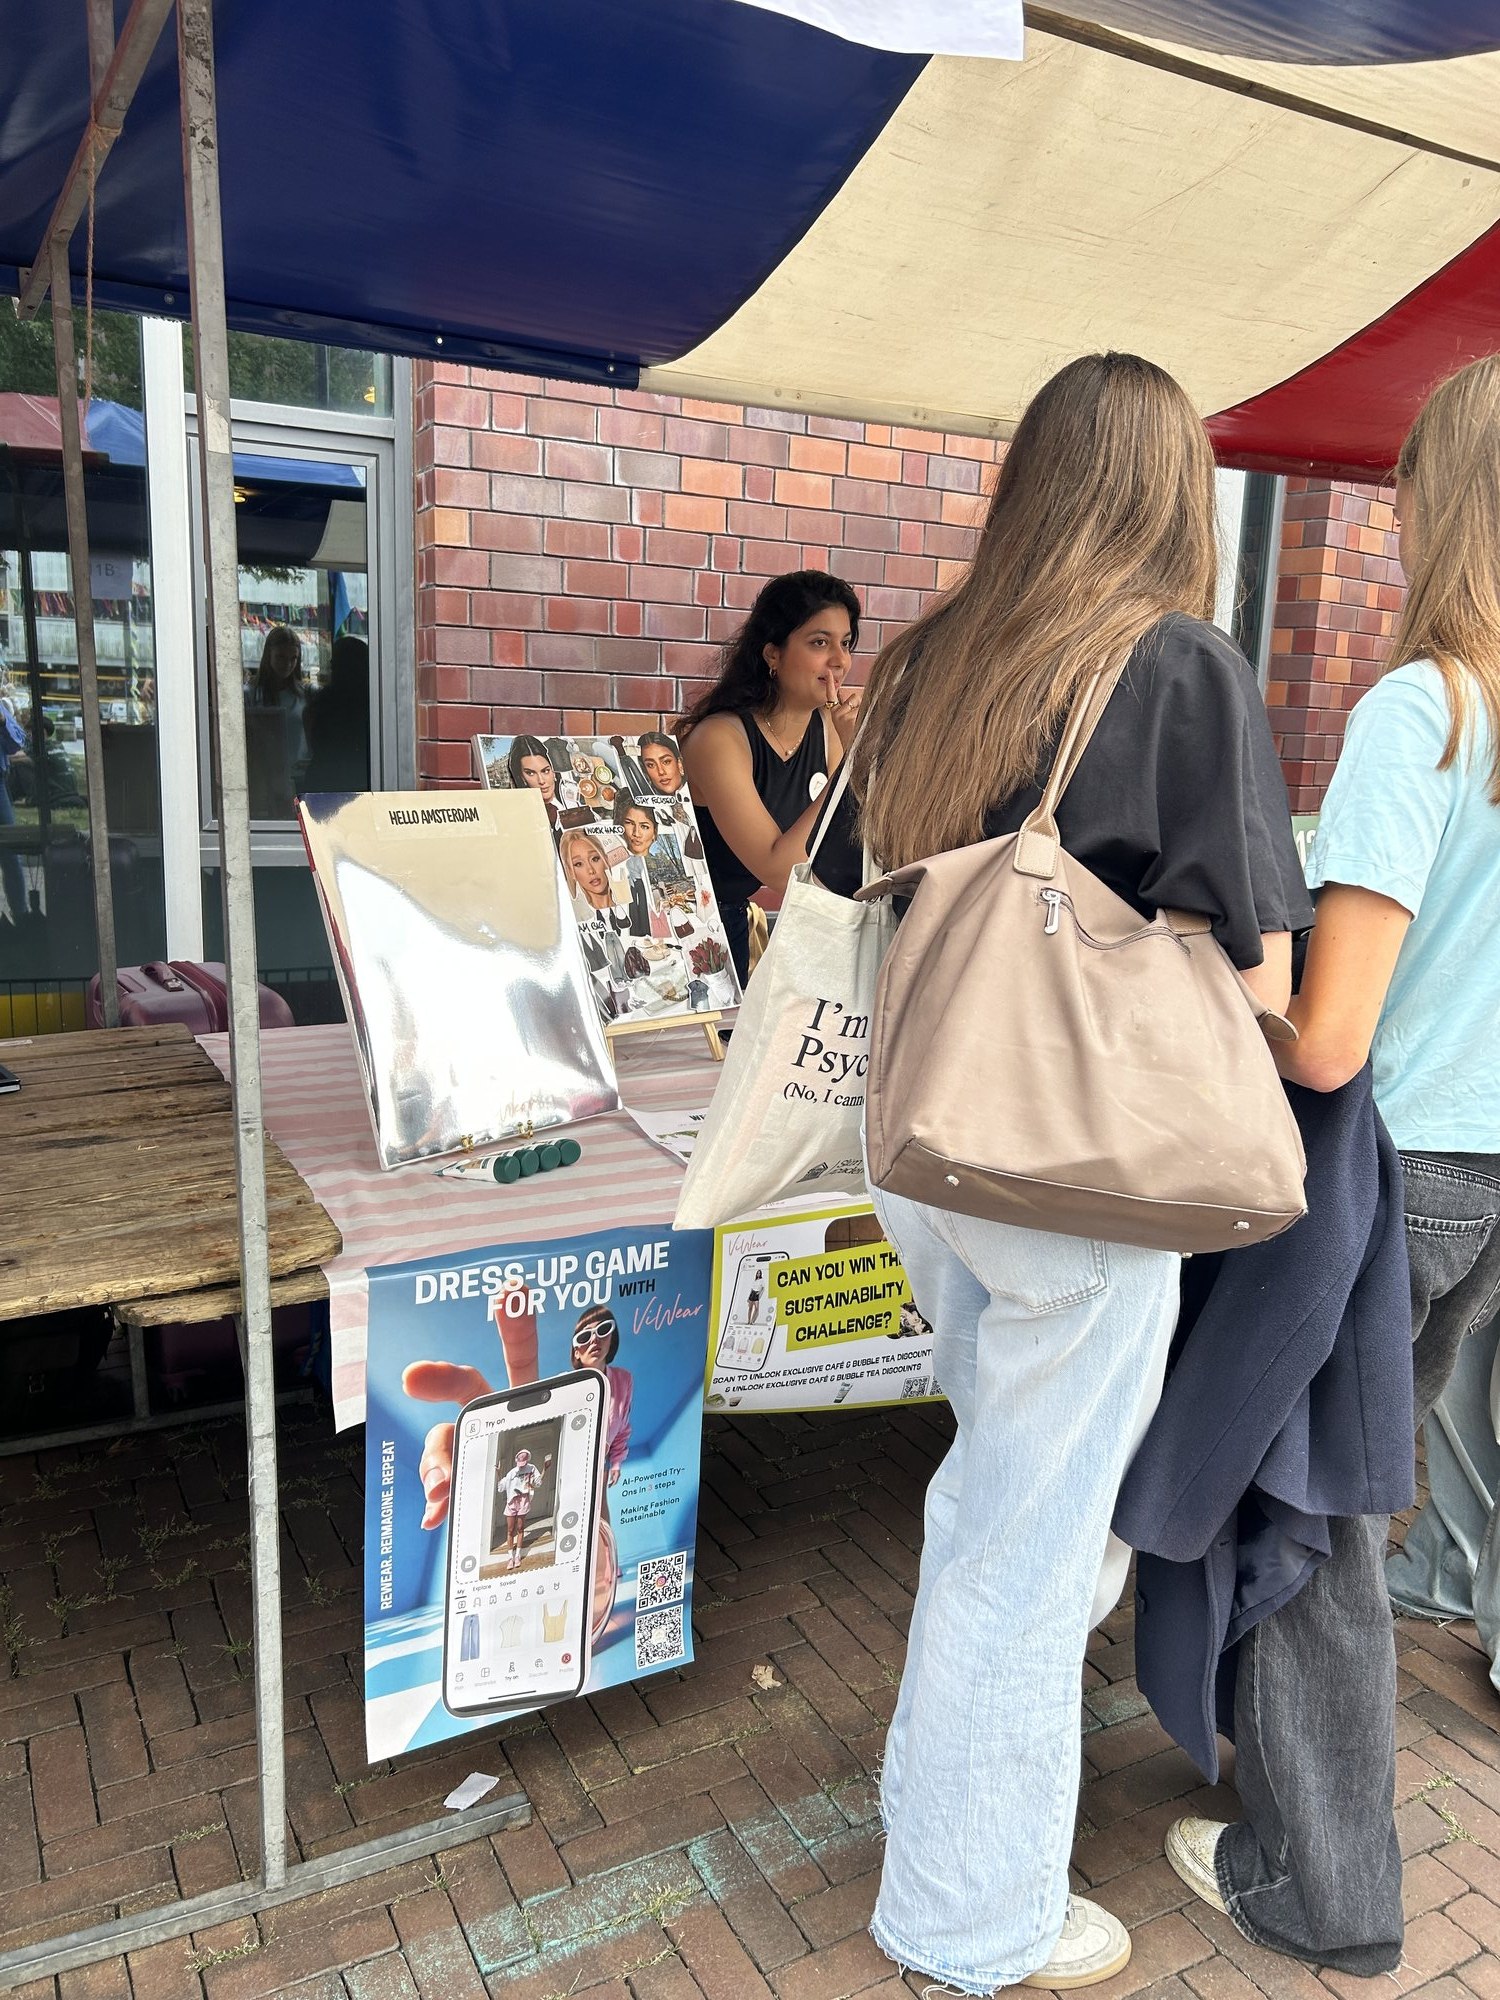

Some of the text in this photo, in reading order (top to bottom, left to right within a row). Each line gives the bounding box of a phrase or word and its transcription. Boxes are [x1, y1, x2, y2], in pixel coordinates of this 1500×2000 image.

[388, 807, 480, 825] HELLO AMSTERDAM
[806, 997, 869, 1039] I’m
[790, 1033, 869, 1084] Psyc
[783, 1081, 818, 1104] (No,
[822, 1088, 833, 1104] I
[415, 1240, 670, 1305] DRESS-UP GAME
[777, 1251, 902, 1288] CAN YOU WIN TH
[486, 1276, 656, 1322] FOR YOU WITH
[632, 1293, 704, 1335] ViWear
[784, 1279, 905, 1317] SUSTAINABILITY
[795, 1310, 893, 1342] CHALLENGE?
[712, 1376, 737, 1385] SCAN
[749, 1370, 782, 1380] UNLOCK
[782, 1364, 824, 1377] EXCLUSIVE
[852, 1356, 880, 1368] BUBBLE
[881, 1354, 896, 1364] TEA
[896, 1348, 933, 1361] DISCOUNT
[732, 1383, 765, 1392] UNLOCK
[765, 1378, 808, 1390] EXCLUSIVE
[836, 1371, 865, 1381] BUBBLE
[866, 1369, 880, 1378] TEA
[881, 1363, 922, 1375] DISCOUNTS
[496, 1417, 506, 1425] on
[621, 1489, 638, 1497] Ons
[639, 1486, 646, 1494] in
[654, 1480, 676, 1490] steps
[622, 1469, 668, 1486] AI-Powered
[620, 1497, 680, 1517] Making Fashion
[620, 1509, 666, 1525] Sustainable
[380, 1440, 395, 1611] REWEAR. REIMAGINE. REPEAT
